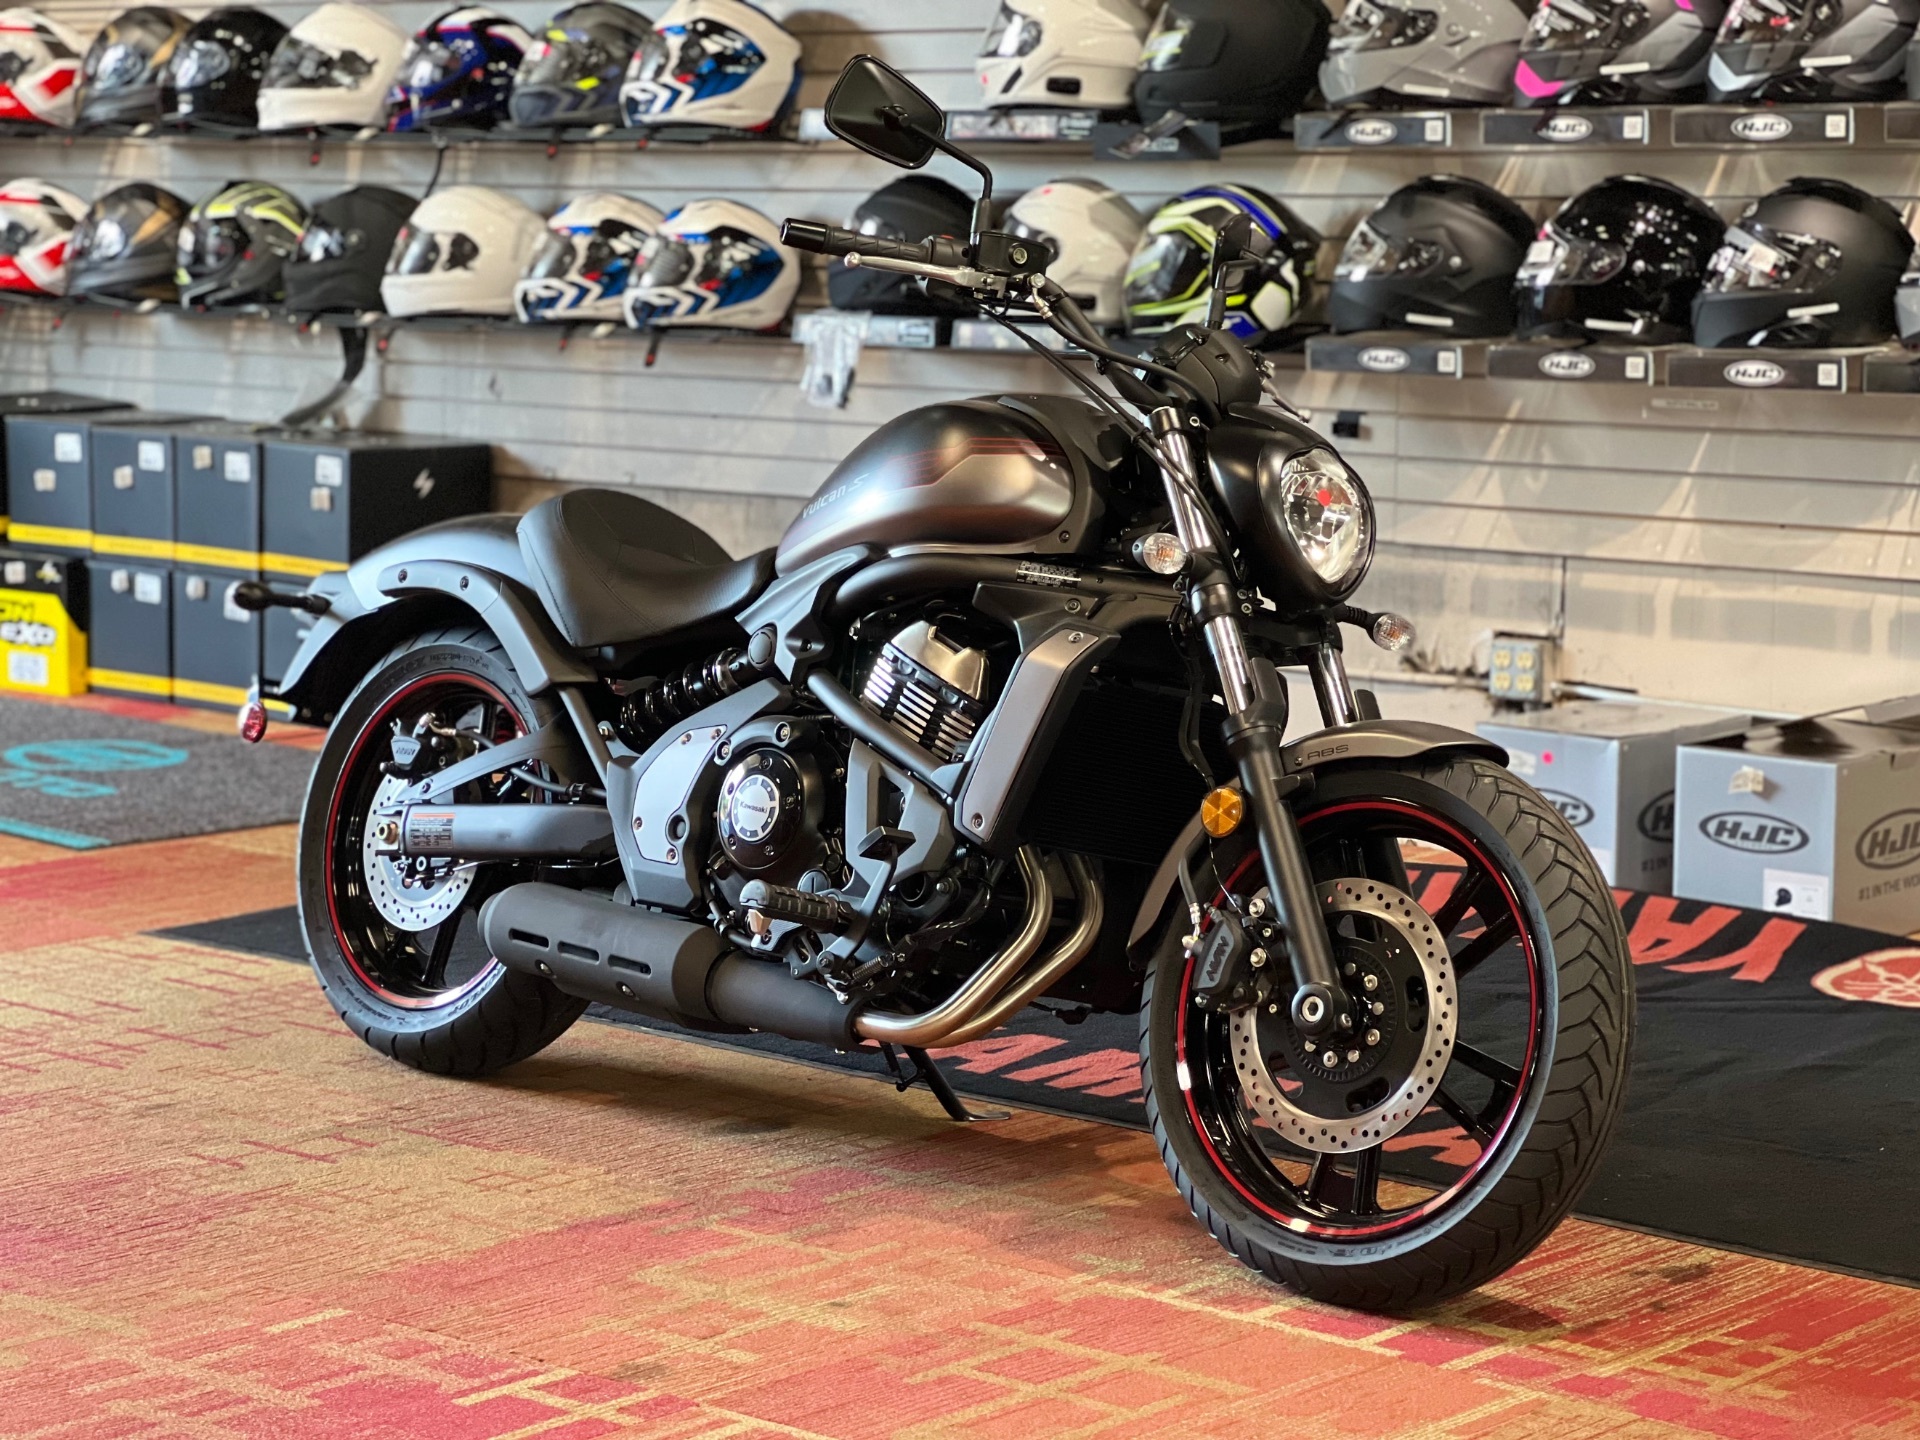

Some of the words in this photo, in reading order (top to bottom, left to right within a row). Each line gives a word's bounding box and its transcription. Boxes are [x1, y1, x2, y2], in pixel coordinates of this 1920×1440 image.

[1740, 121, 1781, 133] HJC
[1734, 367, 1775, 380] HJC
[848, 473, 870, 493] S
[1307, 744, 1349, 760] ABS
[740, 801, 768, 814] Kawasaki
[1713, 819, 1795, 846] HJC
